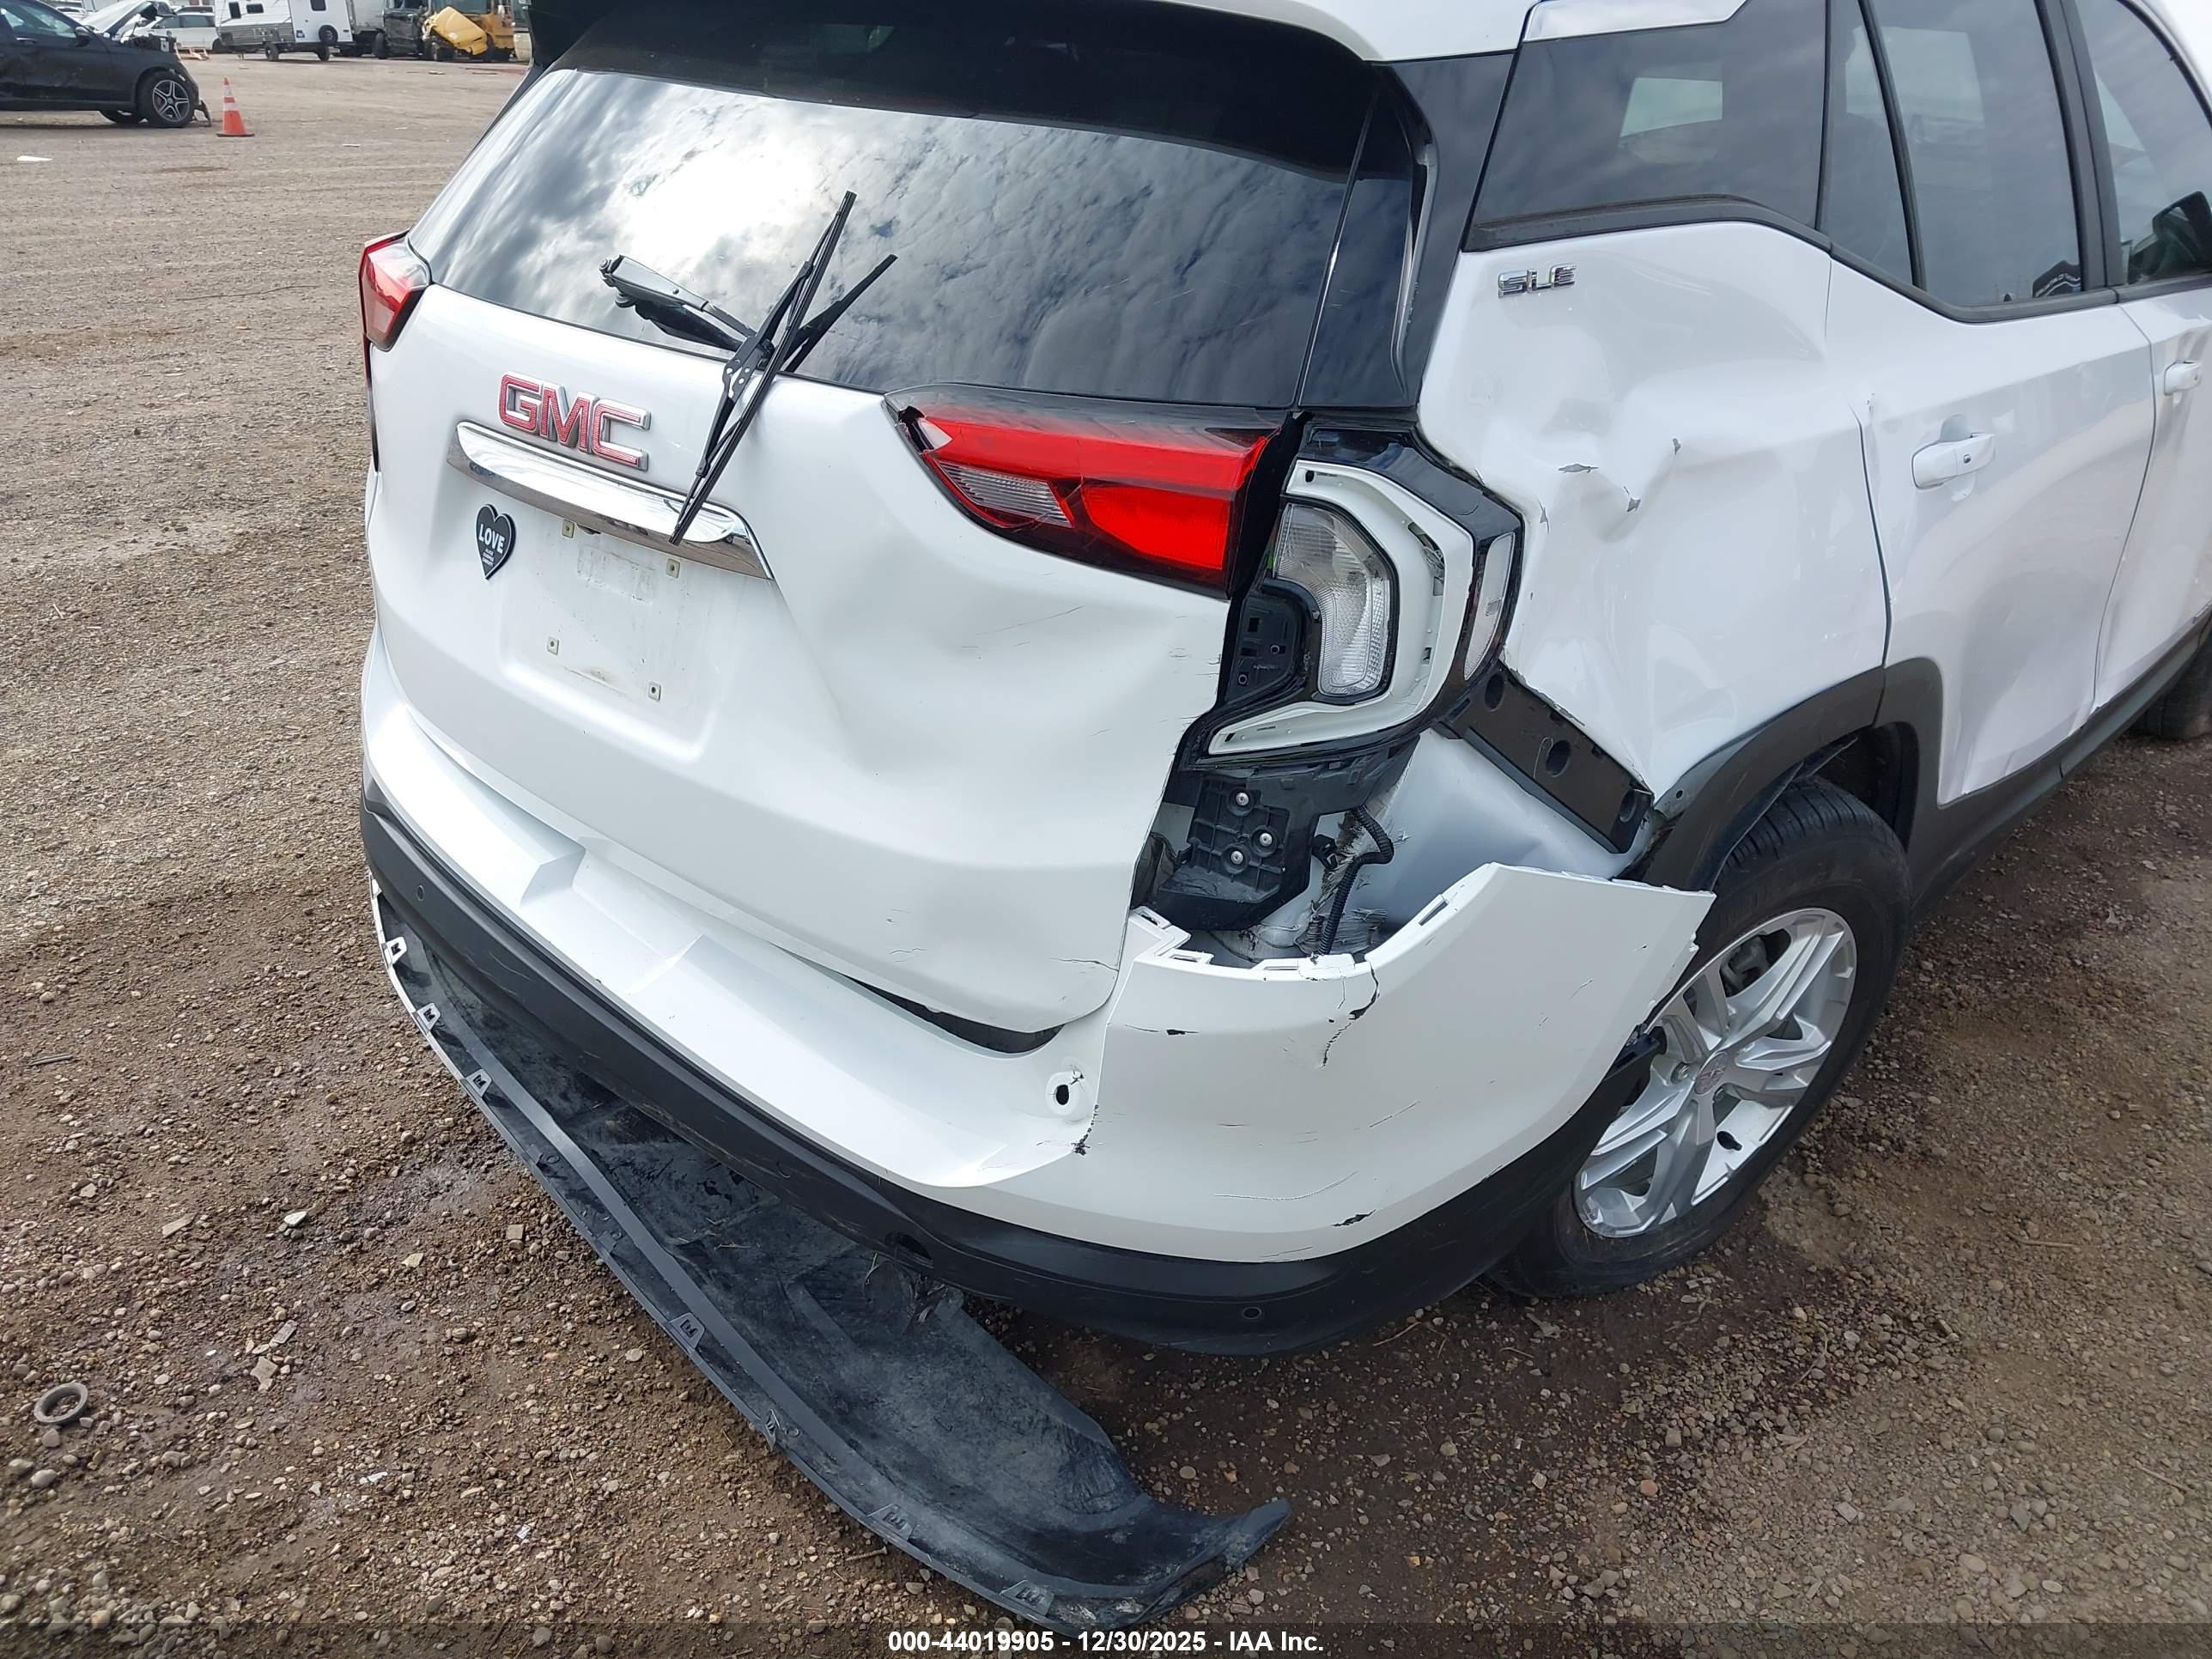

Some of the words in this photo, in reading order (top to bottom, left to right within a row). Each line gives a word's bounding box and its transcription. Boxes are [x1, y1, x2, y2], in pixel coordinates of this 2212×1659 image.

[1498, 263, 1577, 298] SLE
[497, 371, 651, 471] GMC
[478, 524, 505, 555] LOVE
